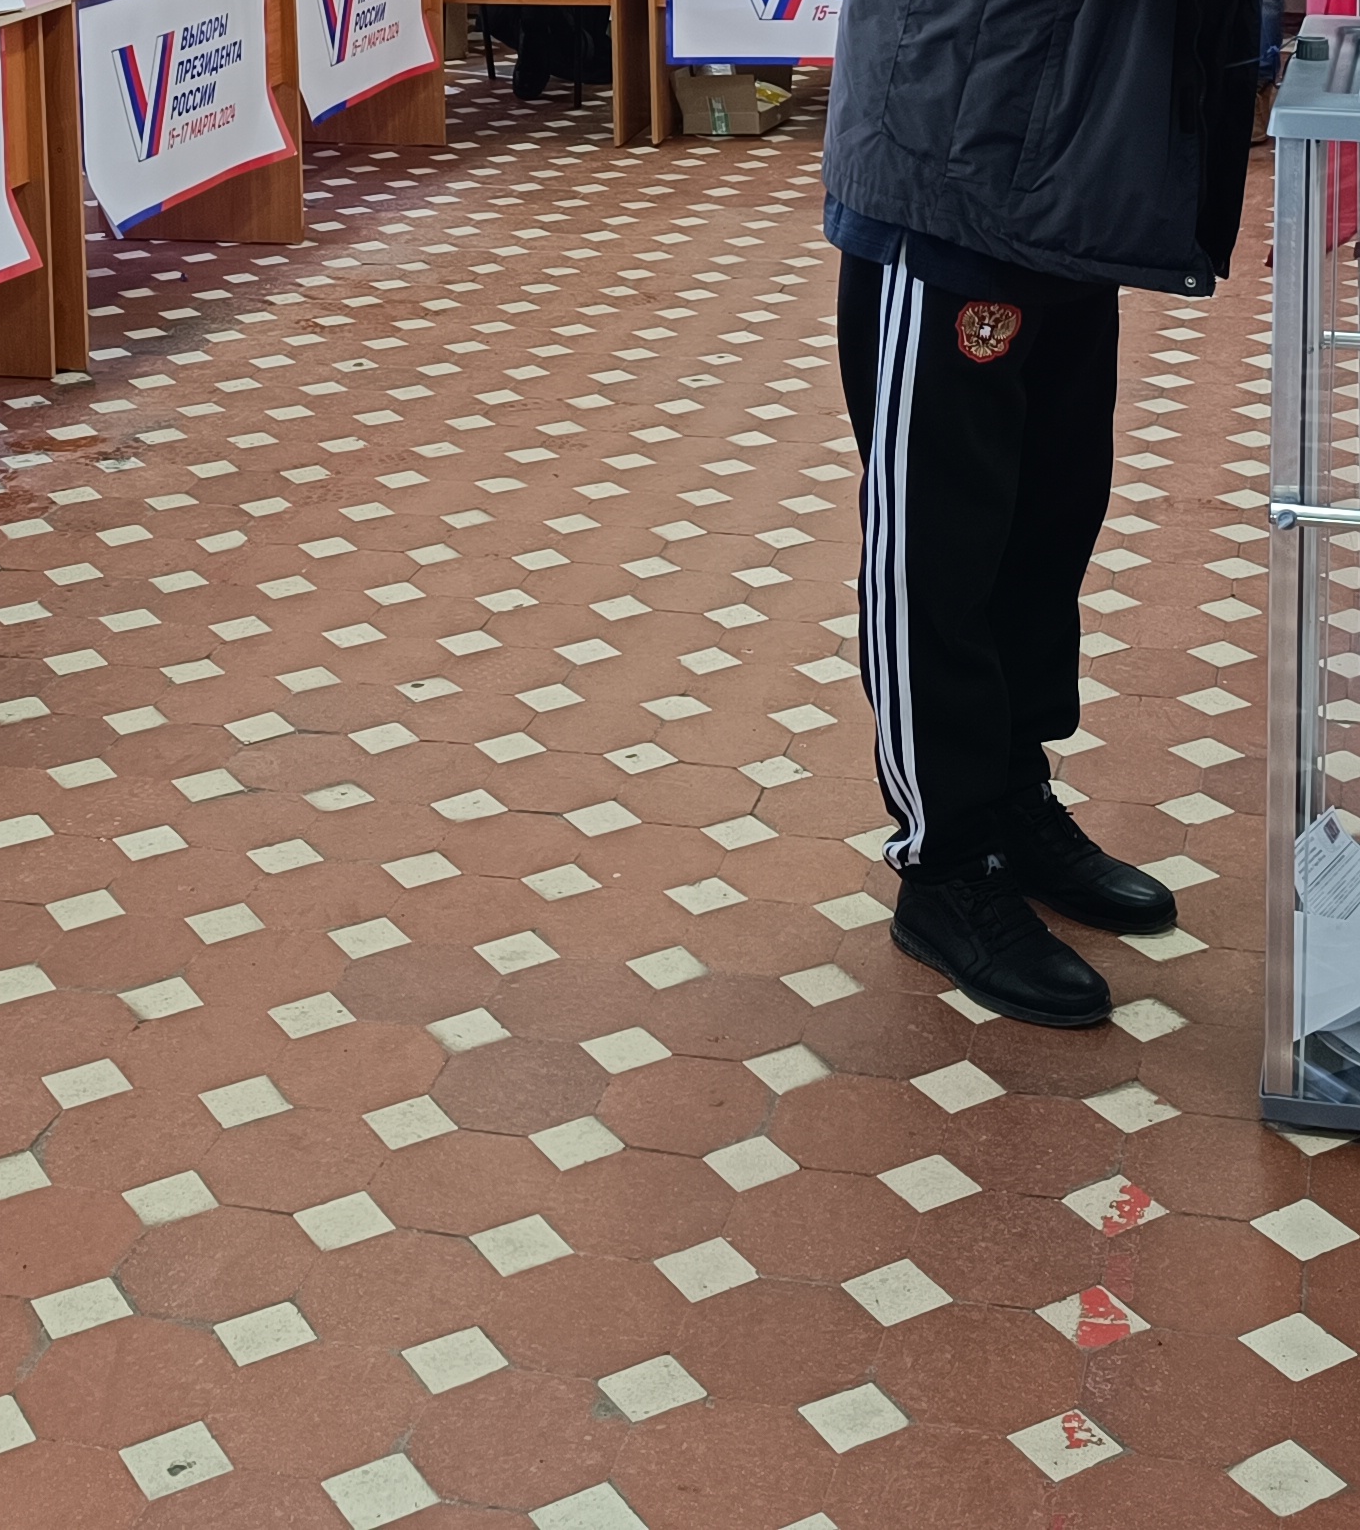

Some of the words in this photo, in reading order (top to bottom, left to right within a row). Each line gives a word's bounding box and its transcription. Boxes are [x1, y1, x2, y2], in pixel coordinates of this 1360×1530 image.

[180, 12, 229, 51] ВЫБОРЫ
[353, 1, 387, 34] РОССИИ
[366, 26, 387, 51] МАРТА
[386, 20, 400, 43] 2024
[175, 38, 243, 86] ПРЕЗИДЕНТА
[170, 80, 217, 121] РОССИИ
[189, 111, 218, 141] МАРТА
[217, 102, 237, 130] 2024
